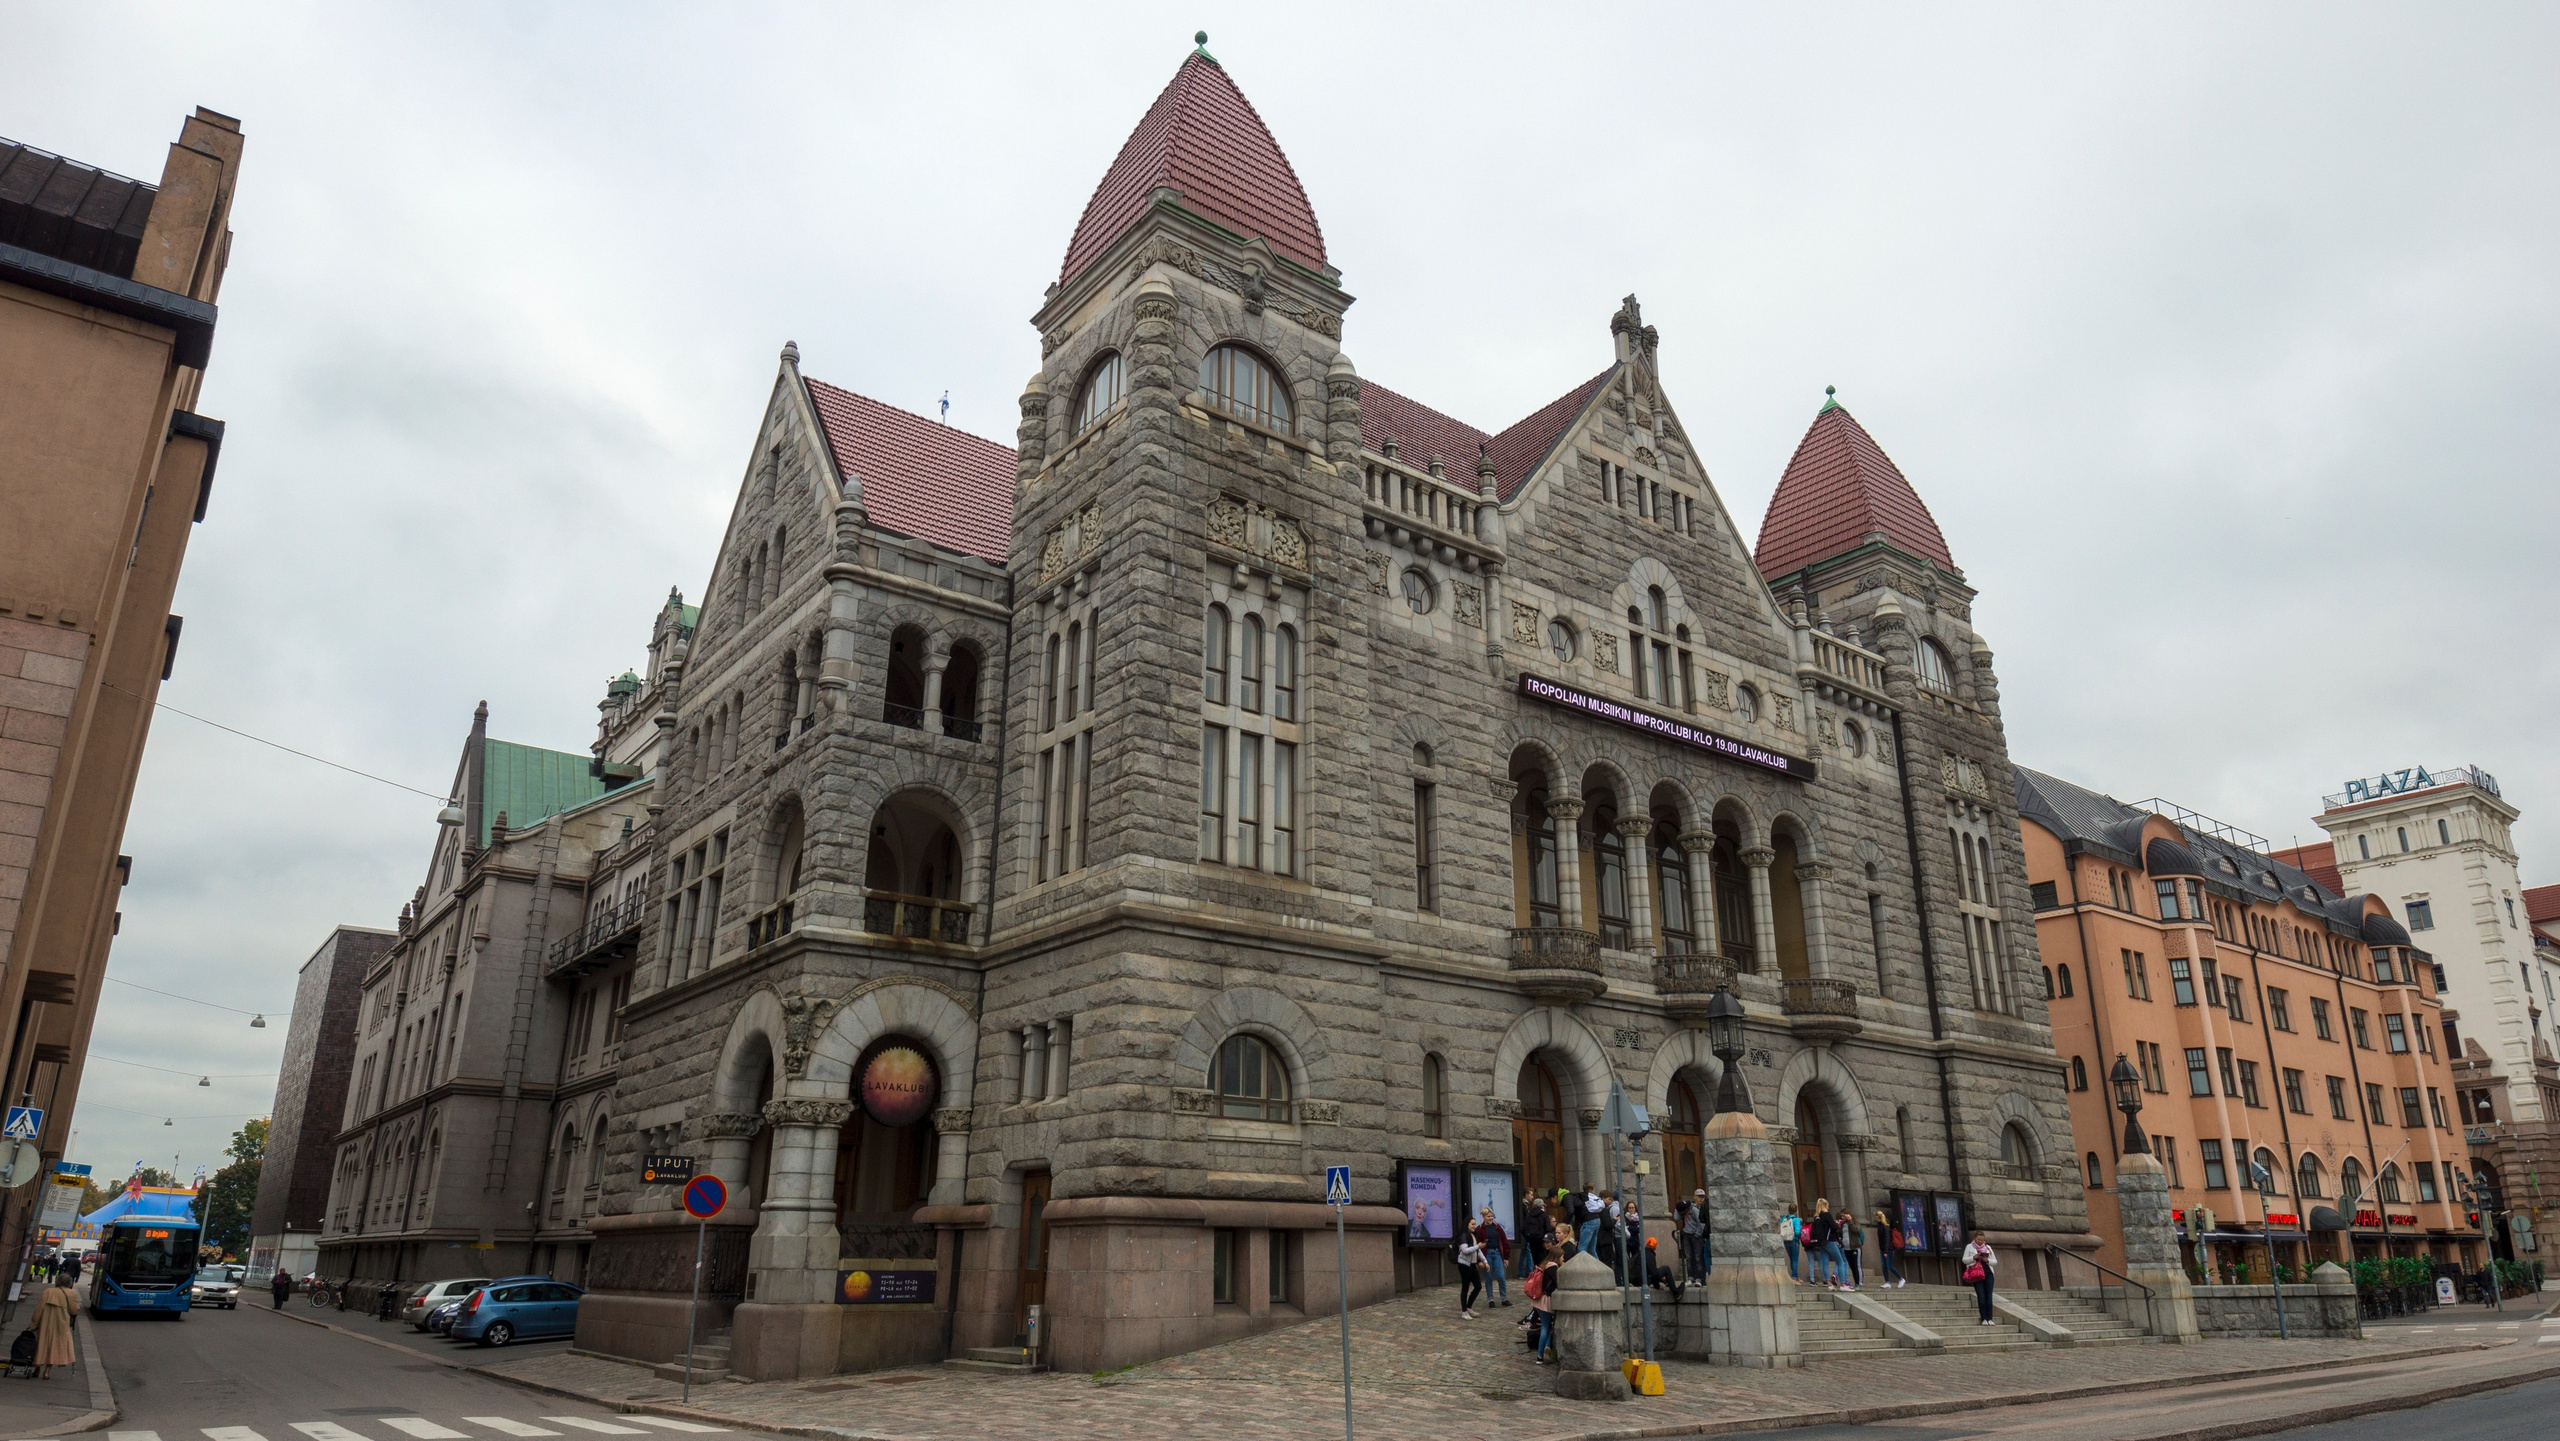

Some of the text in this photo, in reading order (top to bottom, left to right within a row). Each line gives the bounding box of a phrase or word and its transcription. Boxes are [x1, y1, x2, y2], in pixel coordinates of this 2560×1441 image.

[1588, 698, 1631, 721] MUSIIKIN
[1633, 711, 1691, 740] IMPROKLUBI
[1693, 730, 1713, 746] KLO
[1715, 738, 1738, 754] 19.00
[1740, 745, 1788, 769] LAVAKLUBI
[2344, 765, 2435, 803] PLAZA
[868, 1081, 929, 1093] LAVAKLUBI
[647, 1158, 691, 1168] LIPUT
[69, 1164, 79, 1173] 13
[1410, 1176, 1443, 1185] MASENNUS-
[1410, 1183, 1437, 1191] KOMEDIA
